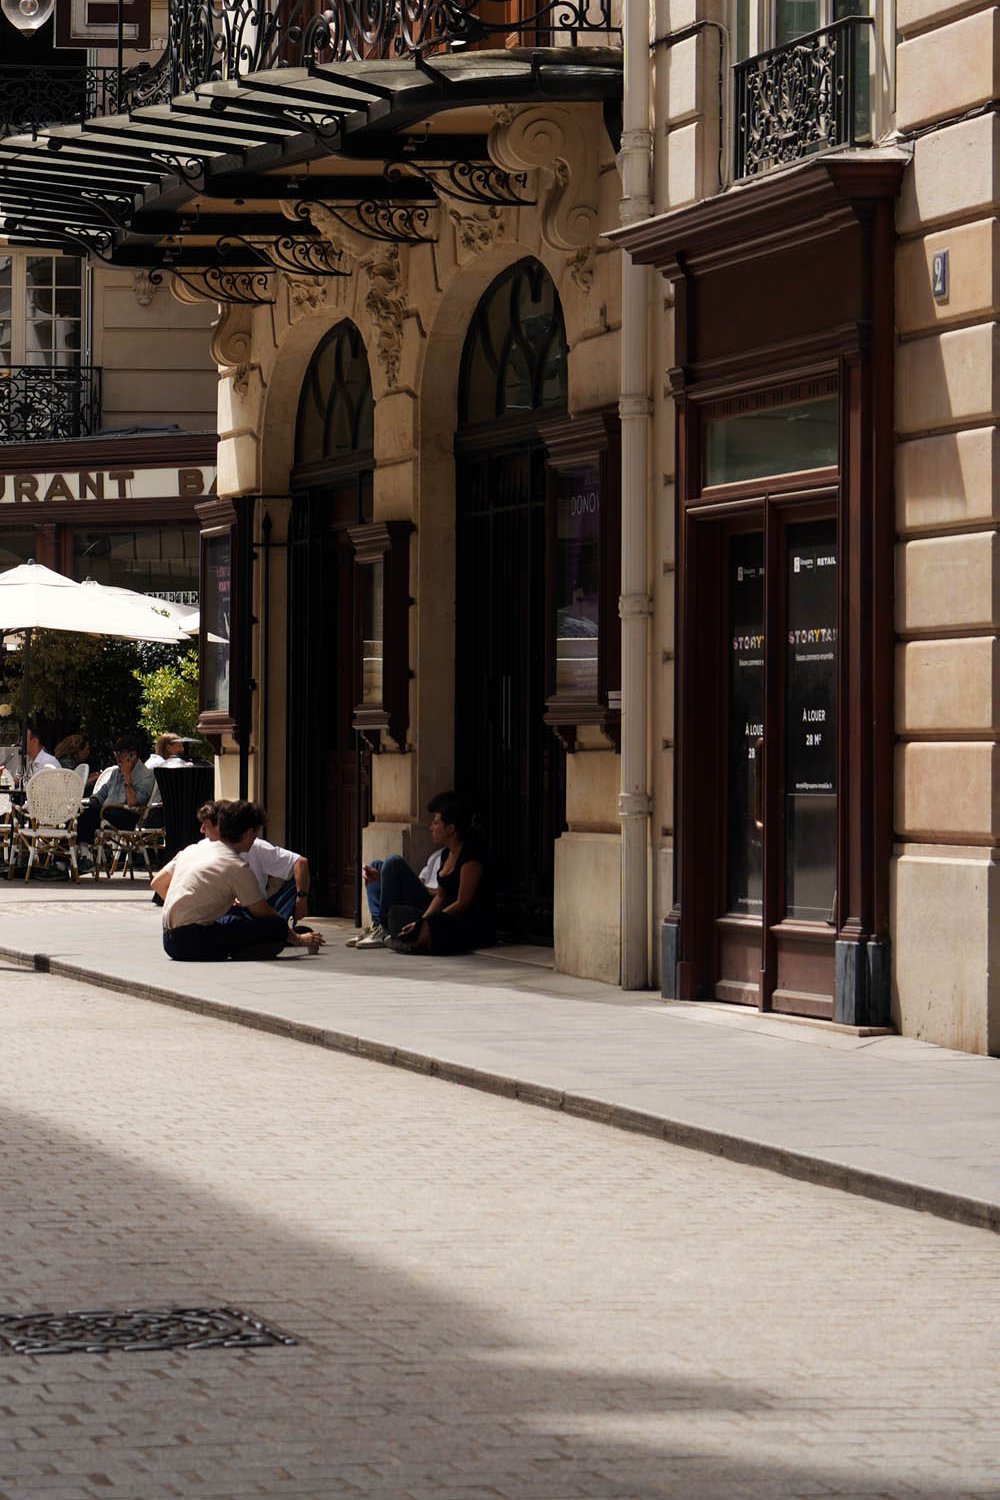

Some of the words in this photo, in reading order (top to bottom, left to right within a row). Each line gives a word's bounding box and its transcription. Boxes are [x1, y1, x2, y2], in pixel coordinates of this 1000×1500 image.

[934, 257, 942, 292] 2
[178, 468, 218, 497] B
[816, 556, 837, 567] RETAIL
[808, 709, 826, 722] LOUER
[806, 733, 814, 746] 28
